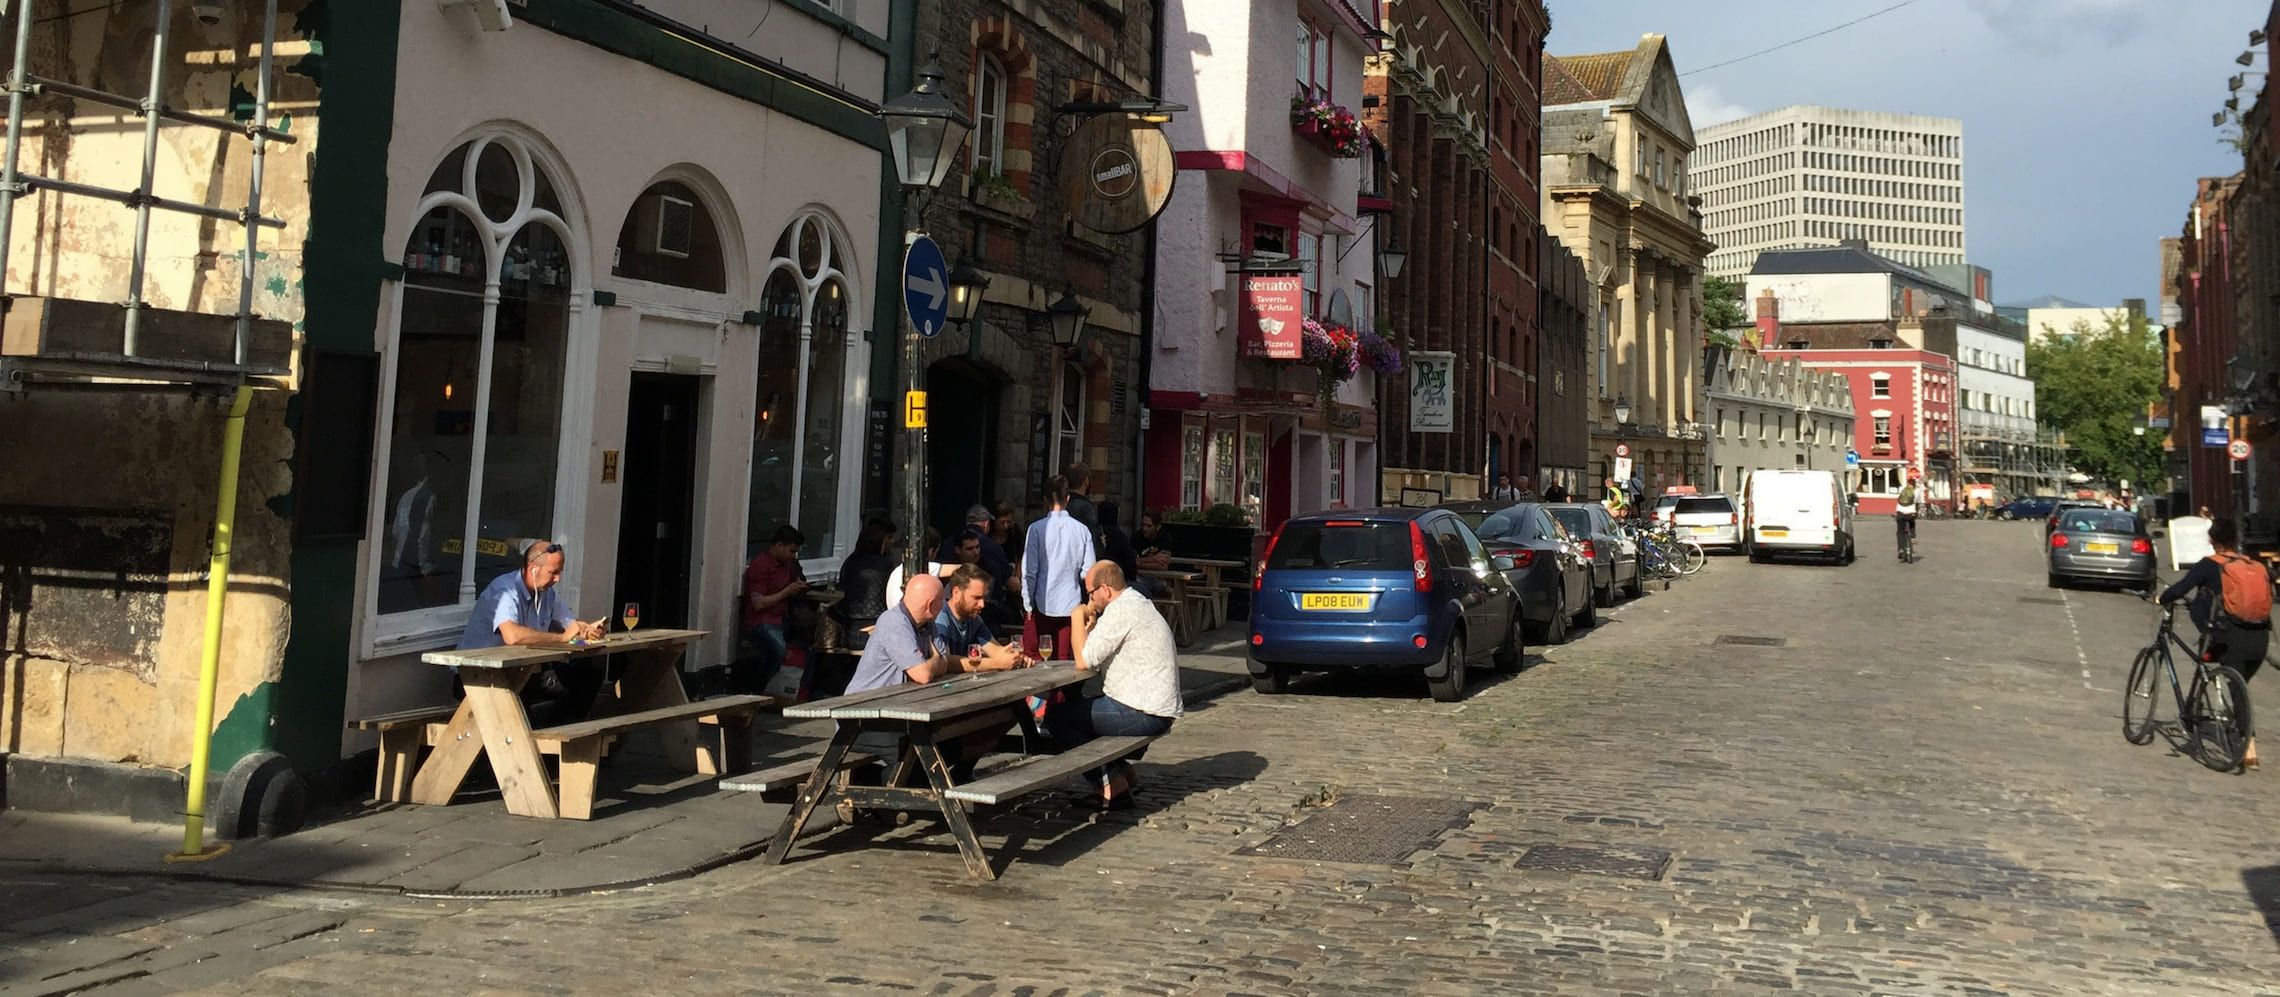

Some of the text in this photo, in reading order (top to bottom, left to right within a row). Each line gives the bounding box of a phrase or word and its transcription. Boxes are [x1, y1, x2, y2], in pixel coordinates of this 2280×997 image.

[1244, 280, 1300, 291] Renato's
[1413, 361, 1446, 396] Raj
[2232, 444, 2248, 454] 20
[1307, 596, 1338, 607] LP08
